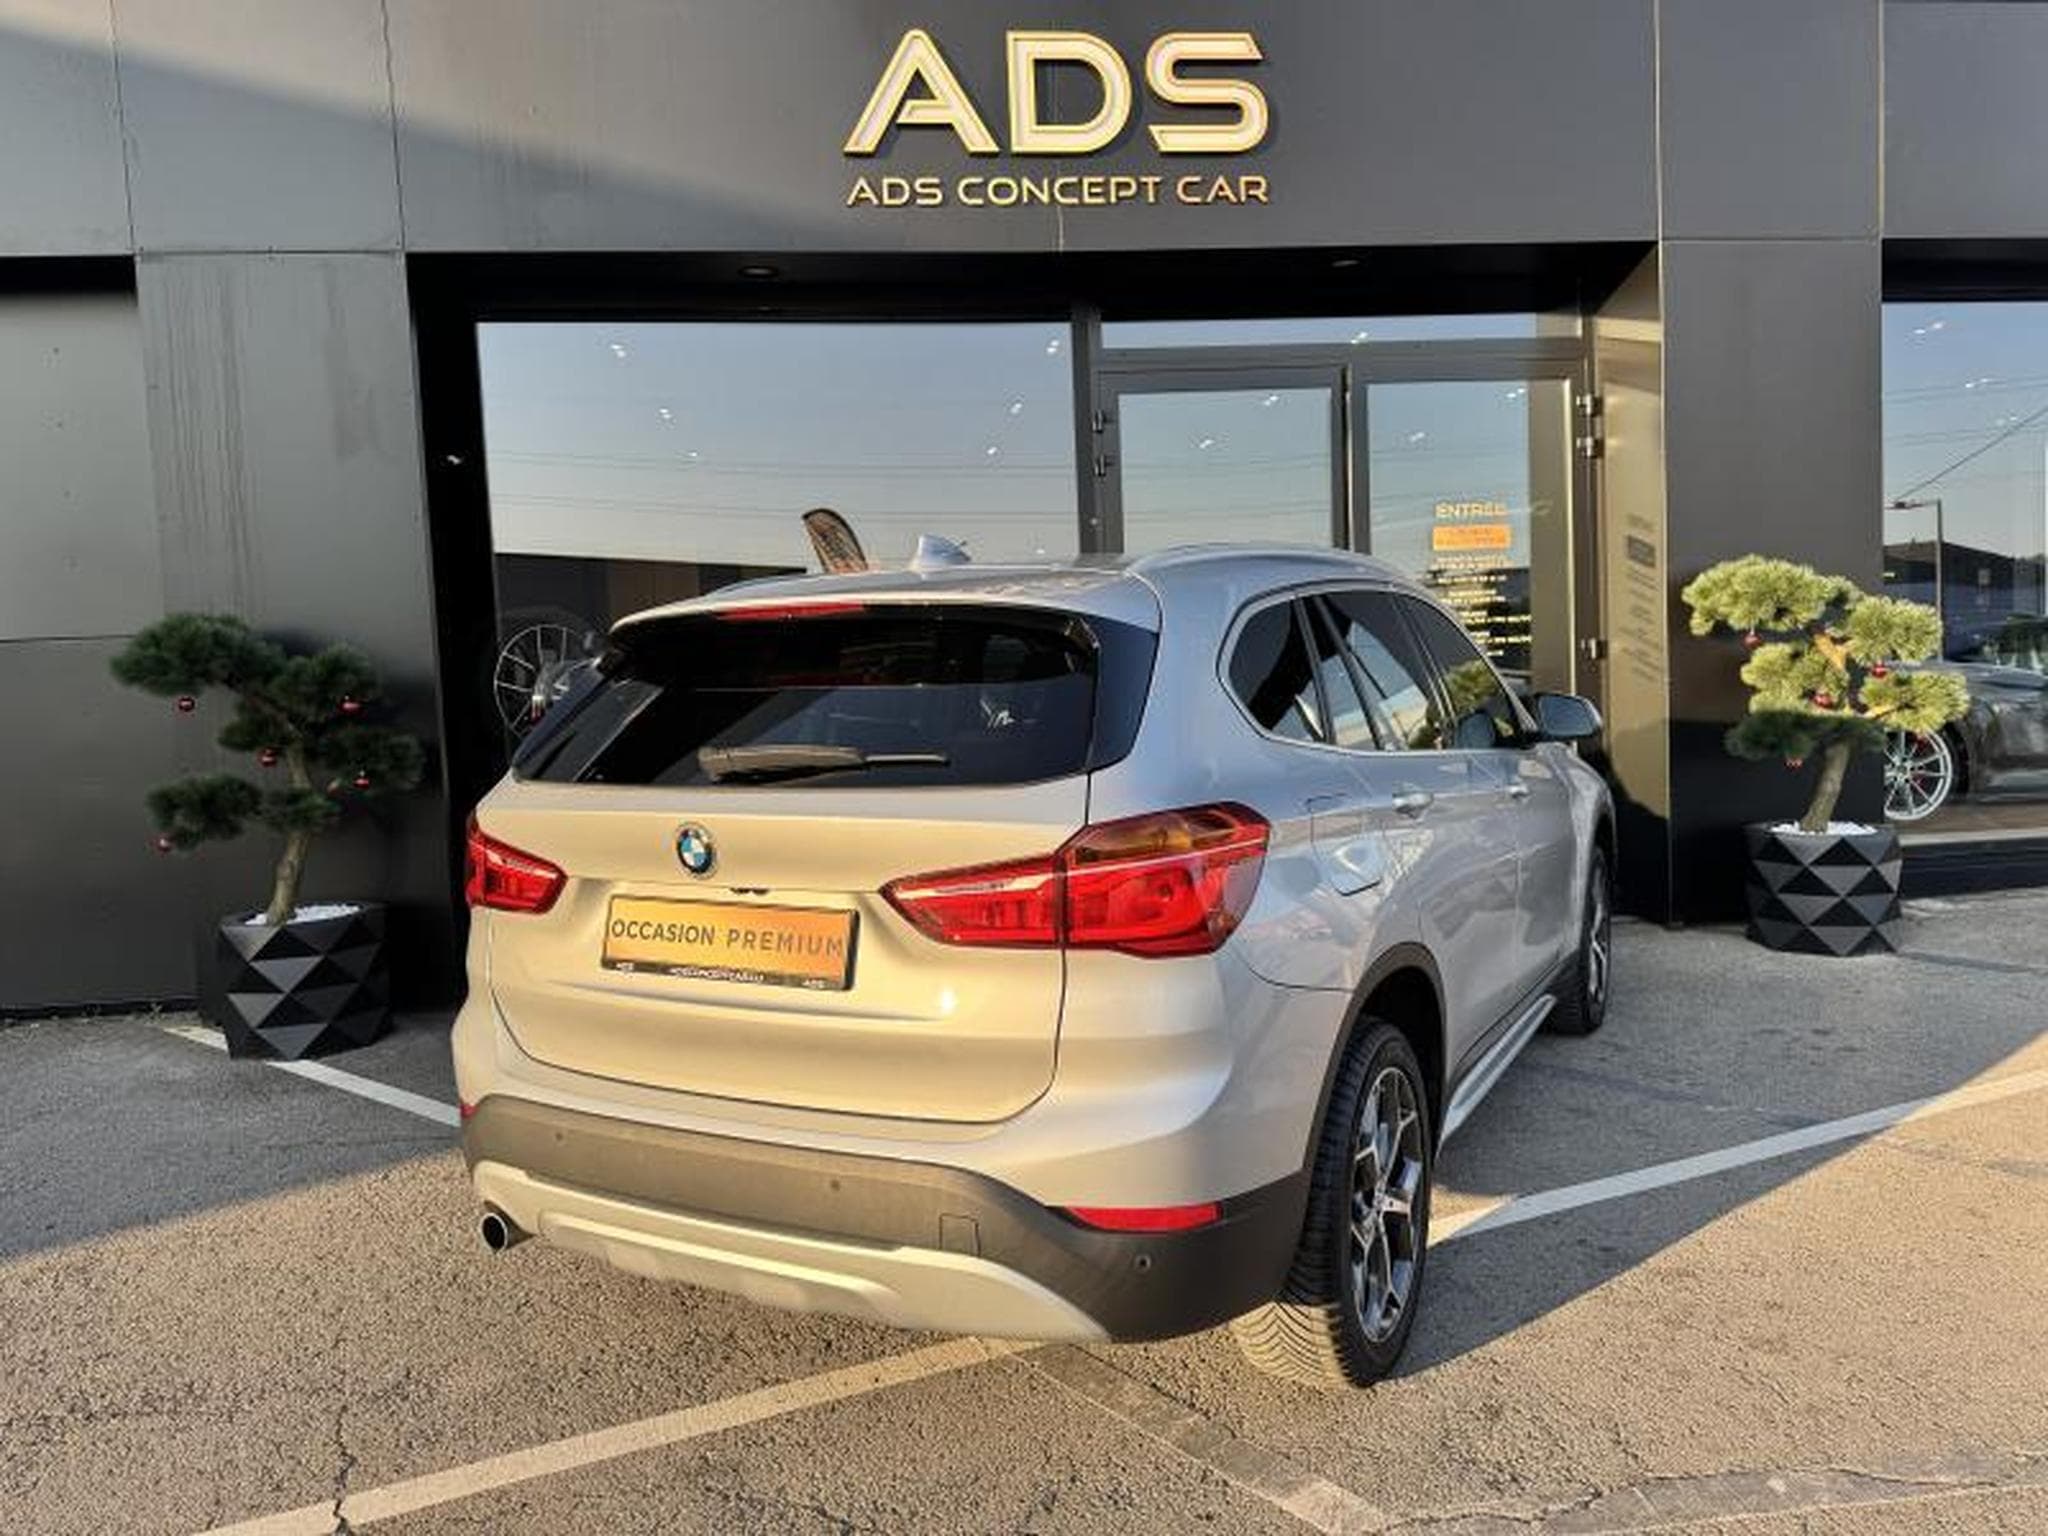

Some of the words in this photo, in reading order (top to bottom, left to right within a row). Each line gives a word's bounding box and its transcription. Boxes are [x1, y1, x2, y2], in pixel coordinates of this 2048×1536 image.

[844, 28, 1269, 154] ADS
[847, 176, 943, 206] ADS
[957, 176, 1161, 206] CONCEPT
[1176, 175, 1269, 206] CAR
[611, 919, 717, 947] OCCASION
[726, 928, 845, 957] PREMIUM
